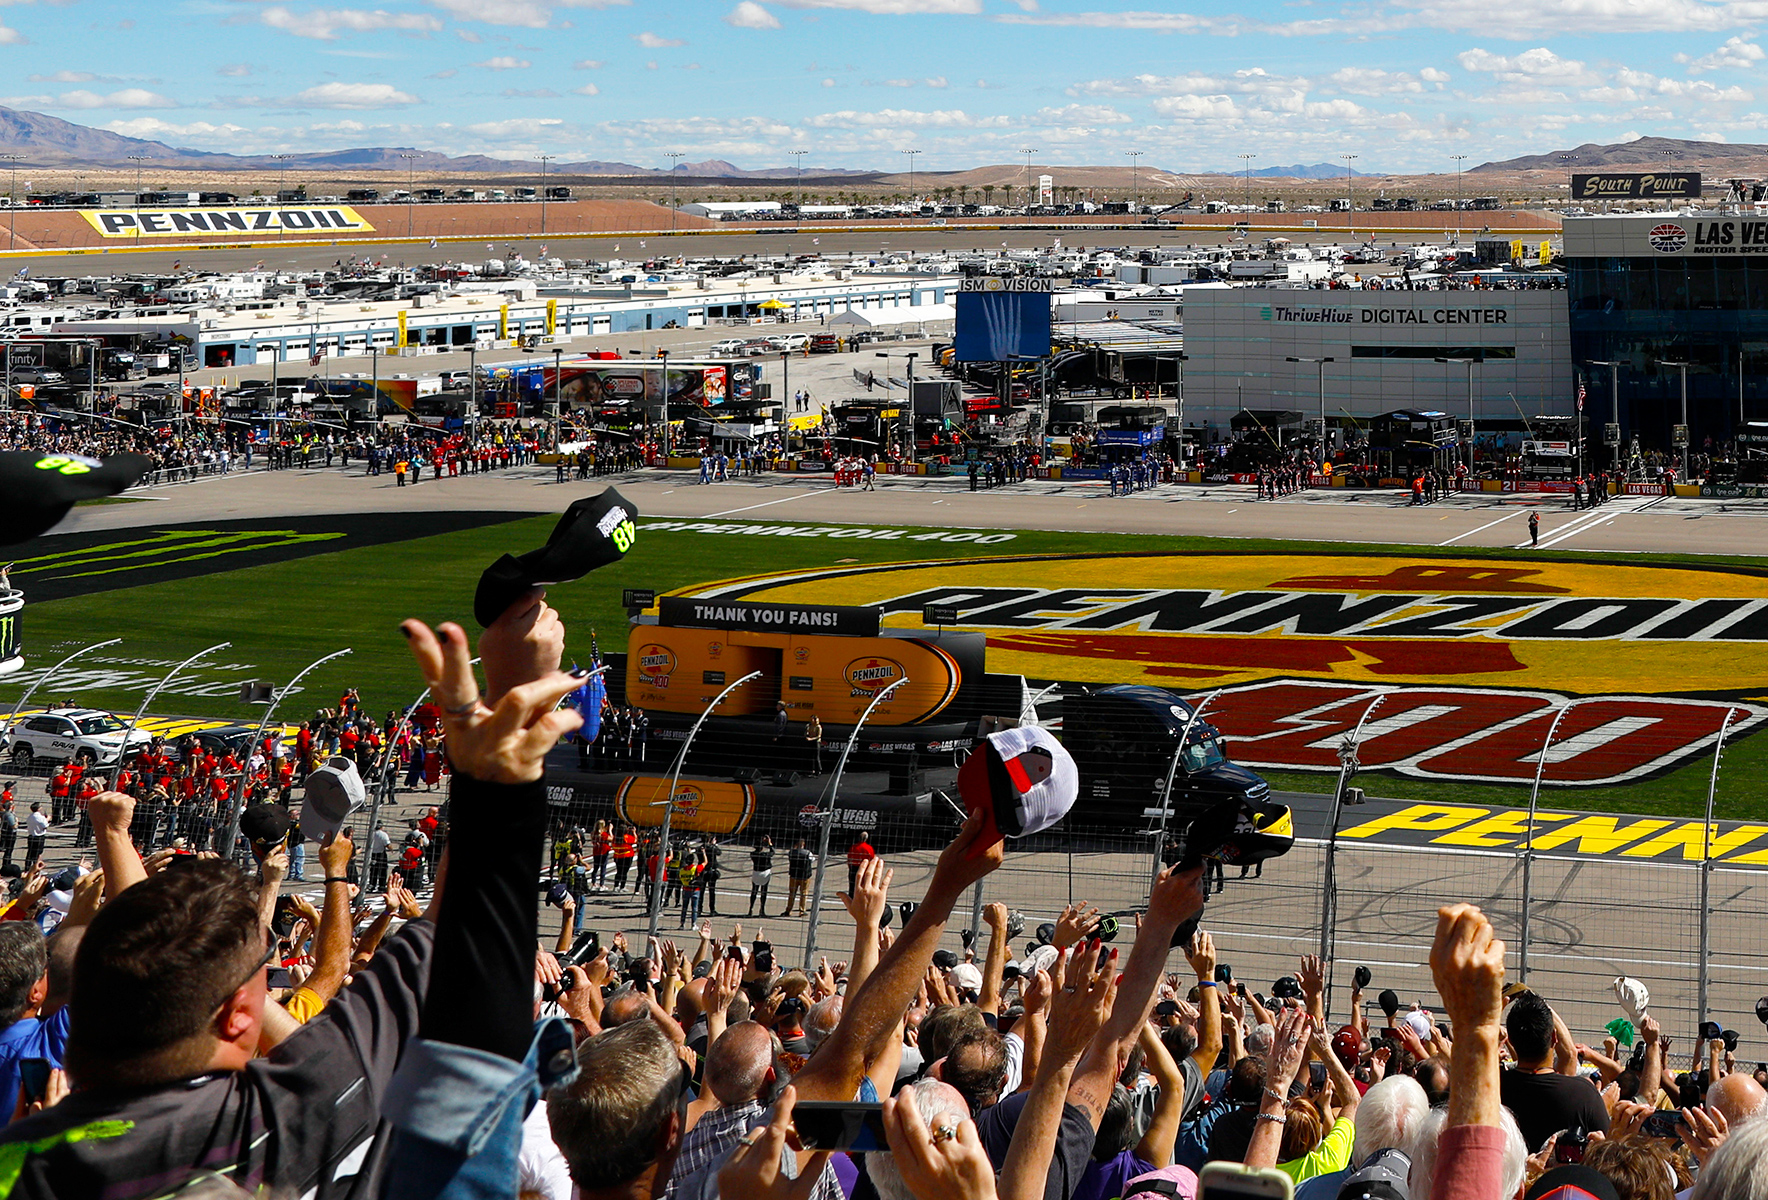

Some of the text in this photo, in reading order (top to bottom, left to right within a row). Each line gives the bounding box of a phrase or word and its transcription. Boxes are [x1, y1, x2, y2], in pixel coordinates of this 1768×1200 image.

[1583, 174, 1689, 197] SOUTH POINT
[98, 210, 363, 233] PENNZOIL
[1693, 223, 1734, 246] LAS
[1693, 246, 1736, 254] MOTOR
[961, 279, 1051, 291] ISM VISION
[1276, 307, 1508, 324] ThriveHive DIGITAL CENTER
[594, 422, 609, 431] ally
[1239, 474, 1250, 483] 41
[1503, 481, 1516, 491] 21
[1628, 486, 1663, 495] LAS VEGAS
[1744, 487, 1757, 496] 14
[612, 519, 636, 553] 48
[694, 605, 838, 627] THANK YOU FANS!
[641, 653, 671, 667] PENNZOIL
[852, 665, 895, 682] PENNZOIL
[652, 674, 670, 689] 400
[51, 740, 76, 750] RAV4
[829, 741, 839, 749] LAS
[894, 743, 916, 751] VEGAS
[941, 738, 973, 750] LAS VEGAS
[842, 809, 879, 823] VEGAS
